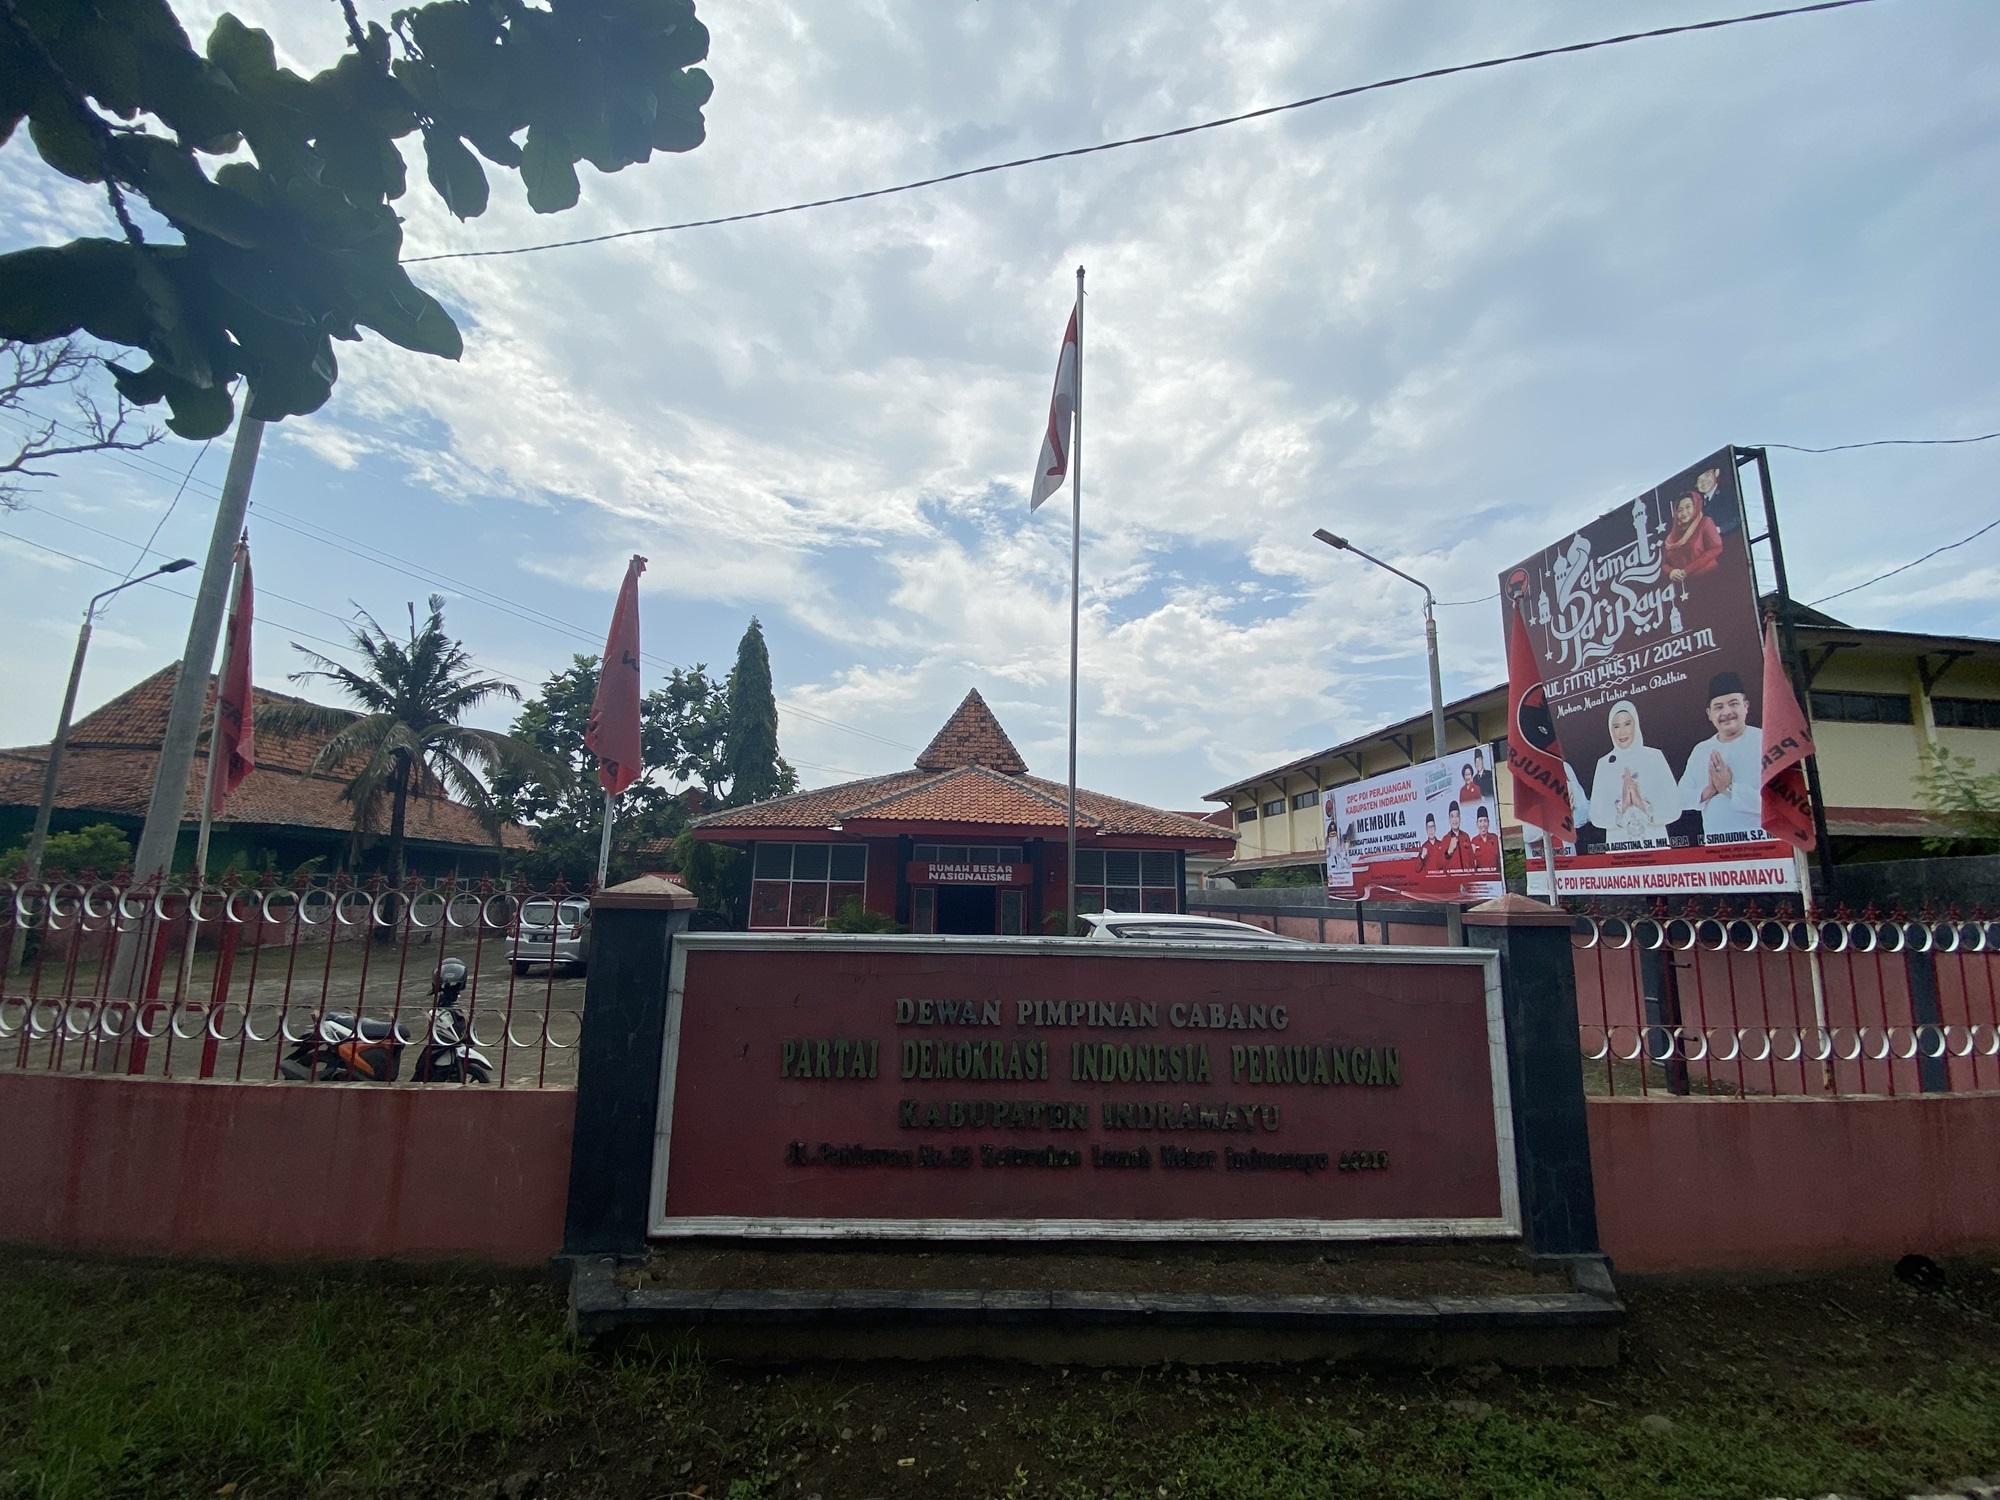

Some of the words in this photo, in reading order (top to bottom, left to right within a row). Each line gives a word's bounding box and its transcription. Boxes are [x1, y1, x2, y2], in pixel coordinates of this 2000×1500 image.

[1603, 577, 1675, 645] Raya
[1563, 668, 1596, 696] FITRI
[1597, 659, 1627, 682] 1445
[1653, 636, 1692, 663] 2024
[1693, 629, 1717, 648] M
[1557, 703, 1582, 718] Mohon
[1582, 690, 1606, 711] Maaf
[1630, 683, 1648, 695] dan
[1649, 671, 1688, 689] Bathin
[1358, 791, 1369, 802] PDI
[1369, 780, 1412, 799] PERJUANGAN
[1345, 801, 1378, 815] KABUPATEN
[1379, 792, 1418, 808] INDRAMAYU
[1356, 810, 1406, 833] MEMBUKA
[1364, 845, 1381, 854] CALON
[1381, 843, 1400, 853] WAKIL
[928, 864, 970, 873] RUMAH
[972, 864, 1013, 874] BESAR
[928, 872, 1013, 882] NASIONALISME
[1565, 876, 1578, 890] PDI
[1580, 874, 1640, 890] PERJUANGAN
[1643, 871, 1706, 888] KABUPATEN
[895, 998, 1002, 1026] DEWAN
[1015, 1000, 1159, 1027] PIMPINAN
[1169, 1002, 1289, 1031] CABANG
[779, 1039, 880, 1079] PARTAI
[900, 1039, 1049, 1080] DEMOKRASI
[1071, 1041, 1214, 1083] INDONESIA
[1230, 1044, 1403, 1086] PERJUANGAN
[898, 1099, 1089, 1129] KABUPATEN
[1102, 1101, 1281, 1132] INDRAMAYU
